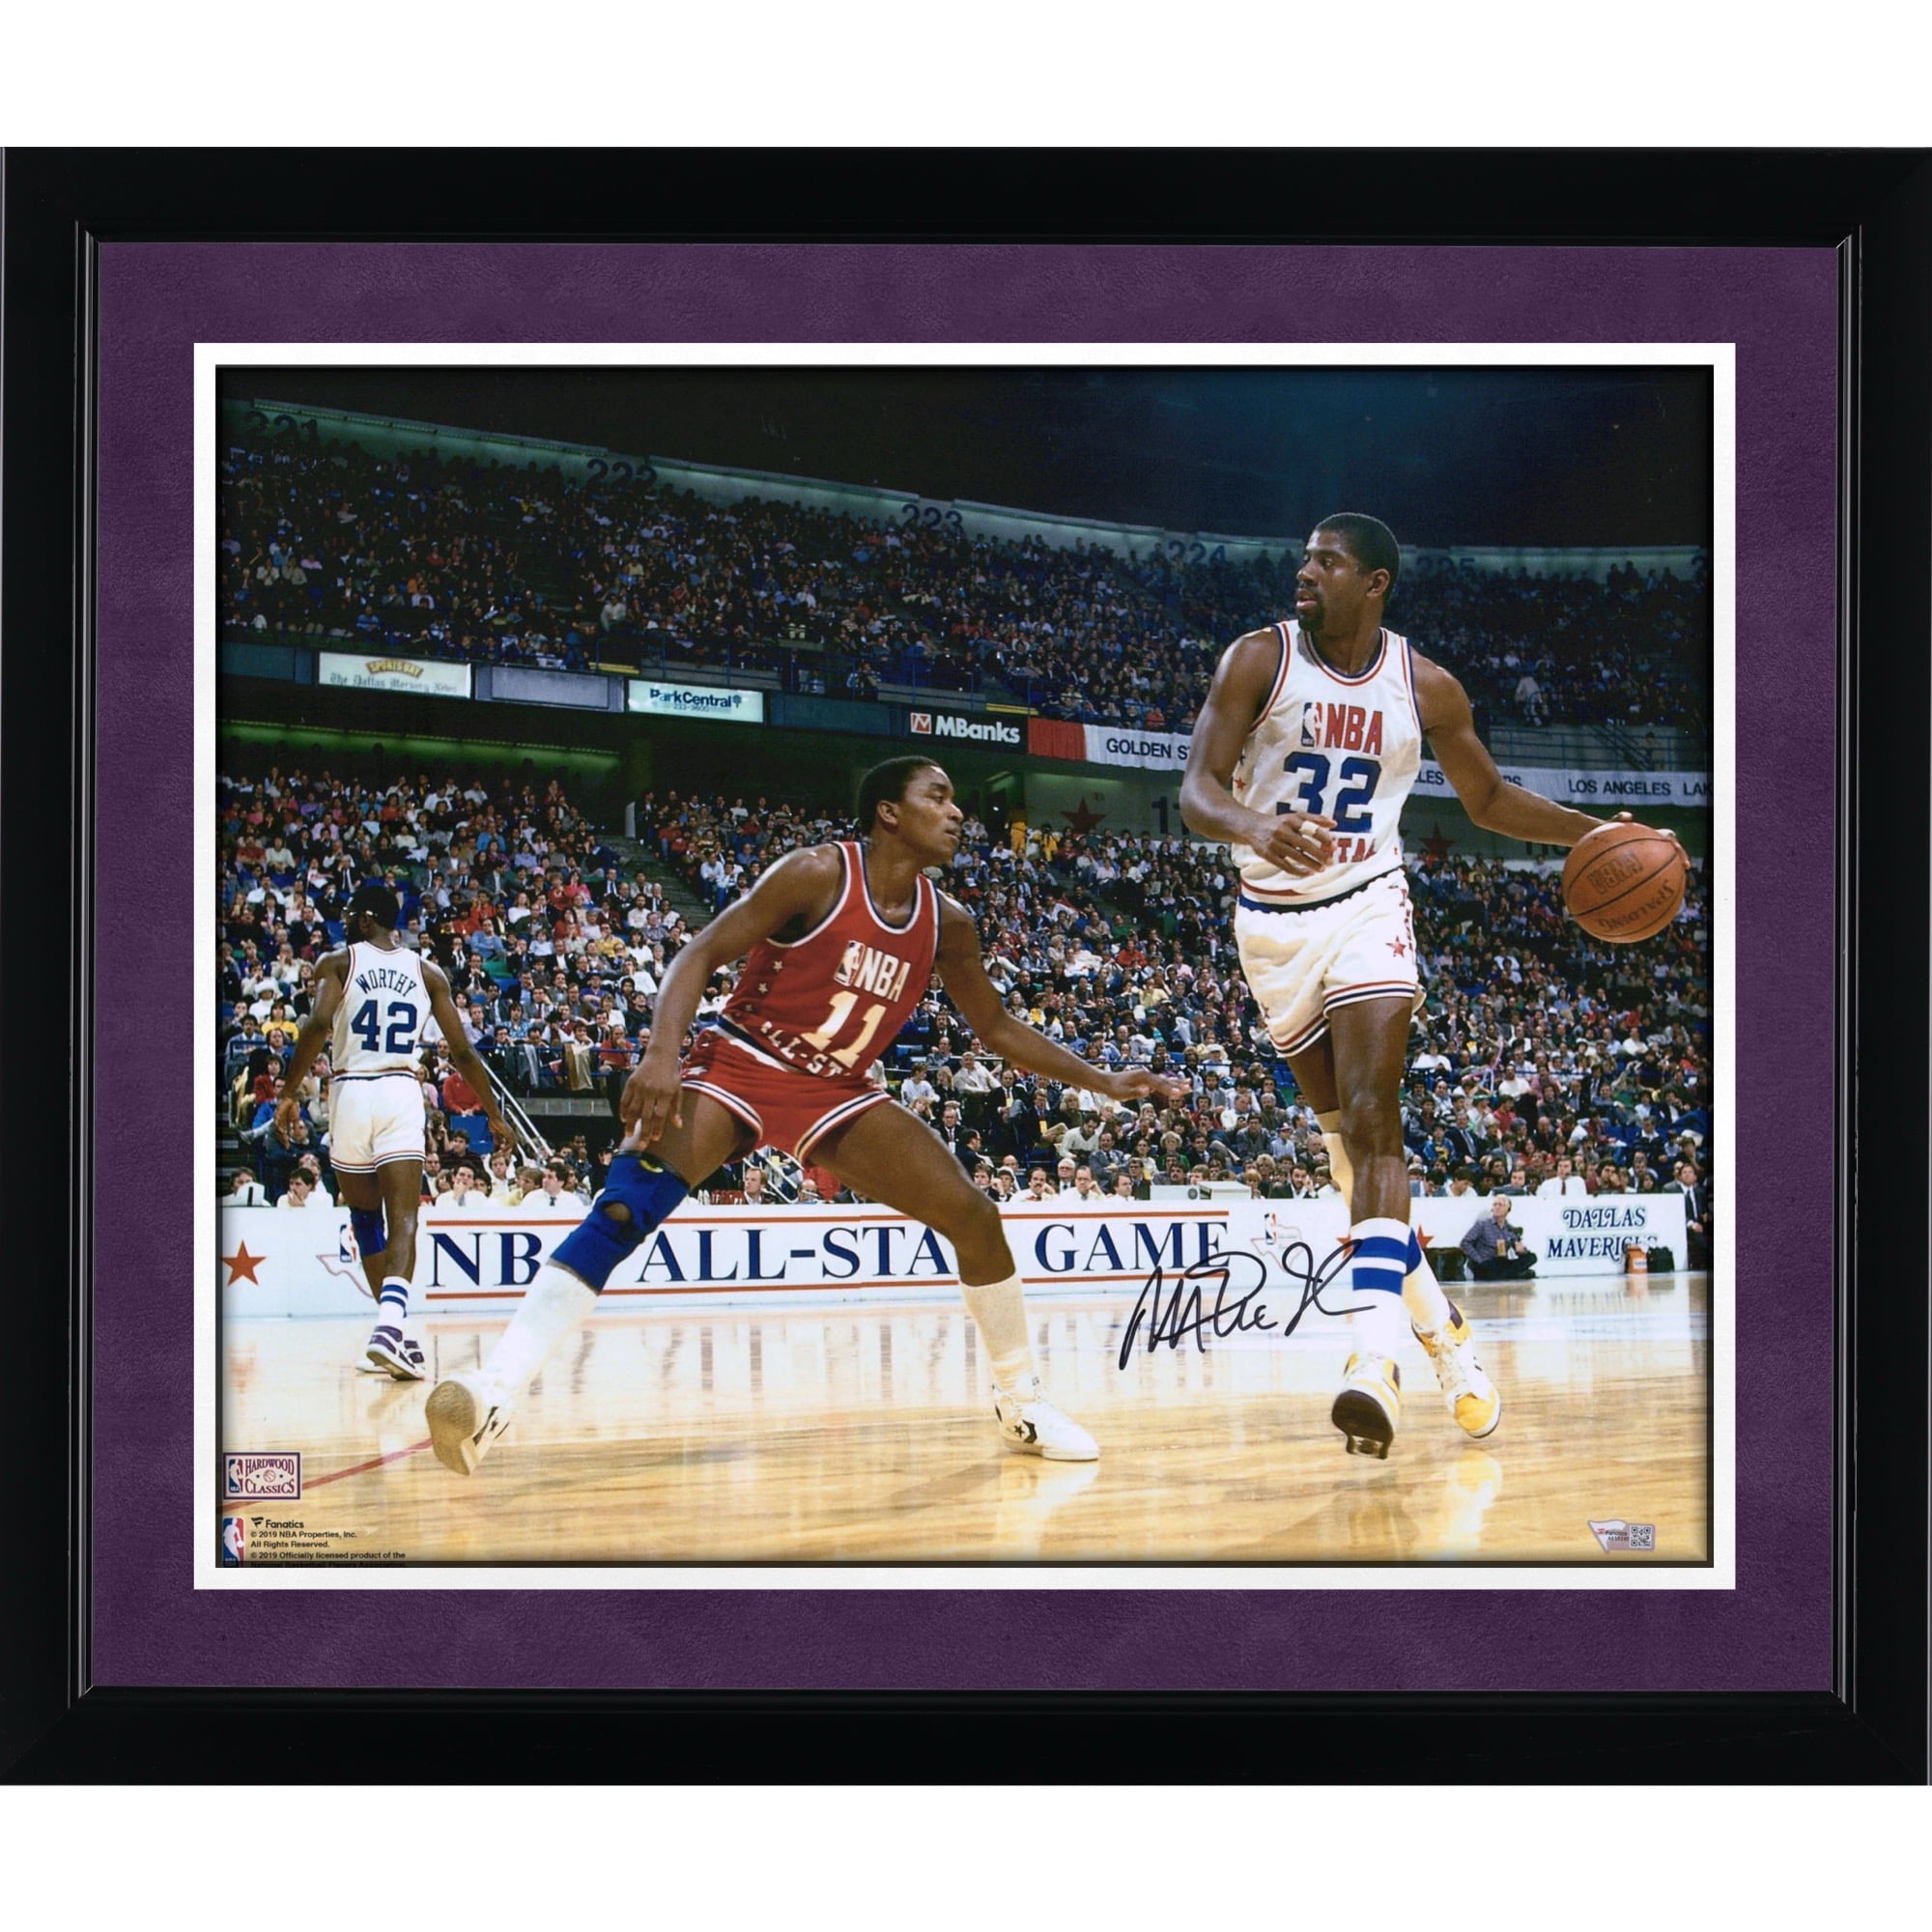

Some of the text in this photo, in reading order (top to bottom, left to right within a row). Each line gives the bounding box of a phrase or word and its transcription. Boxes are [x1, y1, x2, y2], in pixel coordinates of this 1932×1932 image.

[935, 715, 1020, 744] MBanks
[1106, 737, 1172, 759] GOLDEN
[1324, 703, 1383, 755] NBA
[1275, 751, 1382, 833] 32
[1568, 779, 1598, 794] LOS
[1603, 780, 1671, 797] ANGELES
[355, 968, 418, 997] WORTHY
[854, 947, 912, 1003] NBA
[351, 999, 418, 1054] 42
[800, 990, 887, 1069] 11
[1562, 1207, 1646, 1229] DALLAS
[635, 1225, 953, 1283] ALL-STA
[1034, 1221, 1231, 1272] GAME
